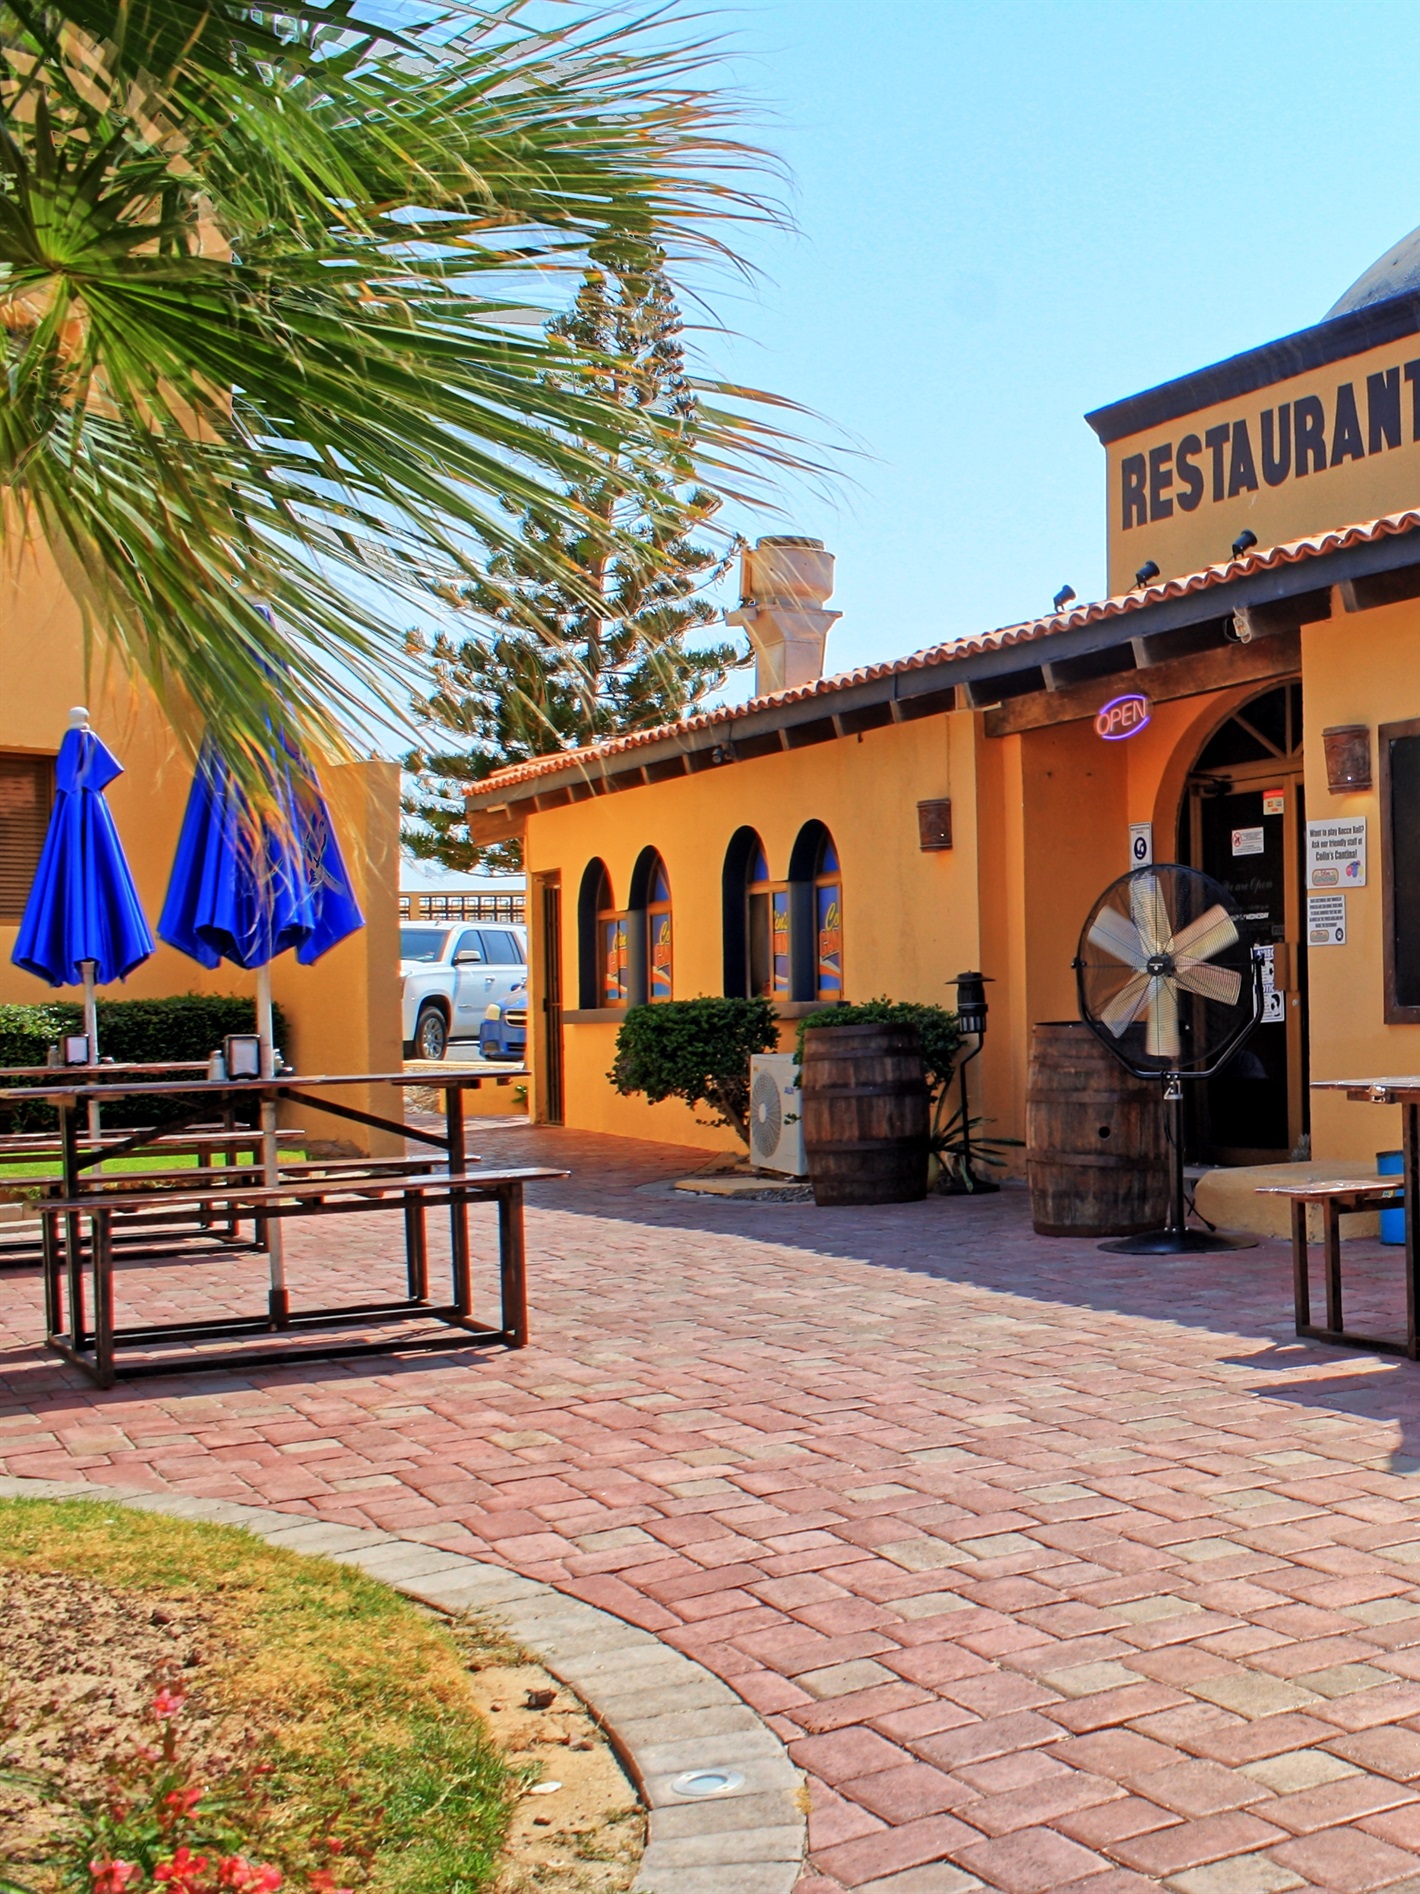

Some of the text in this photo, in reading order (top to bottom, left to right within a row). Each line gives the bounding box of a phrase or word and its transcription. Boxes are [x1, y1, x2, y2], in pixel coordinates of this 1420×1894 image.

[1096, 698, 1146, 735] OPEN
[1338, 827, 1352, 835] Bocce
[1329, 838, 1346, 847] friendly
[1316, 851, 1334, 861] Colin's
